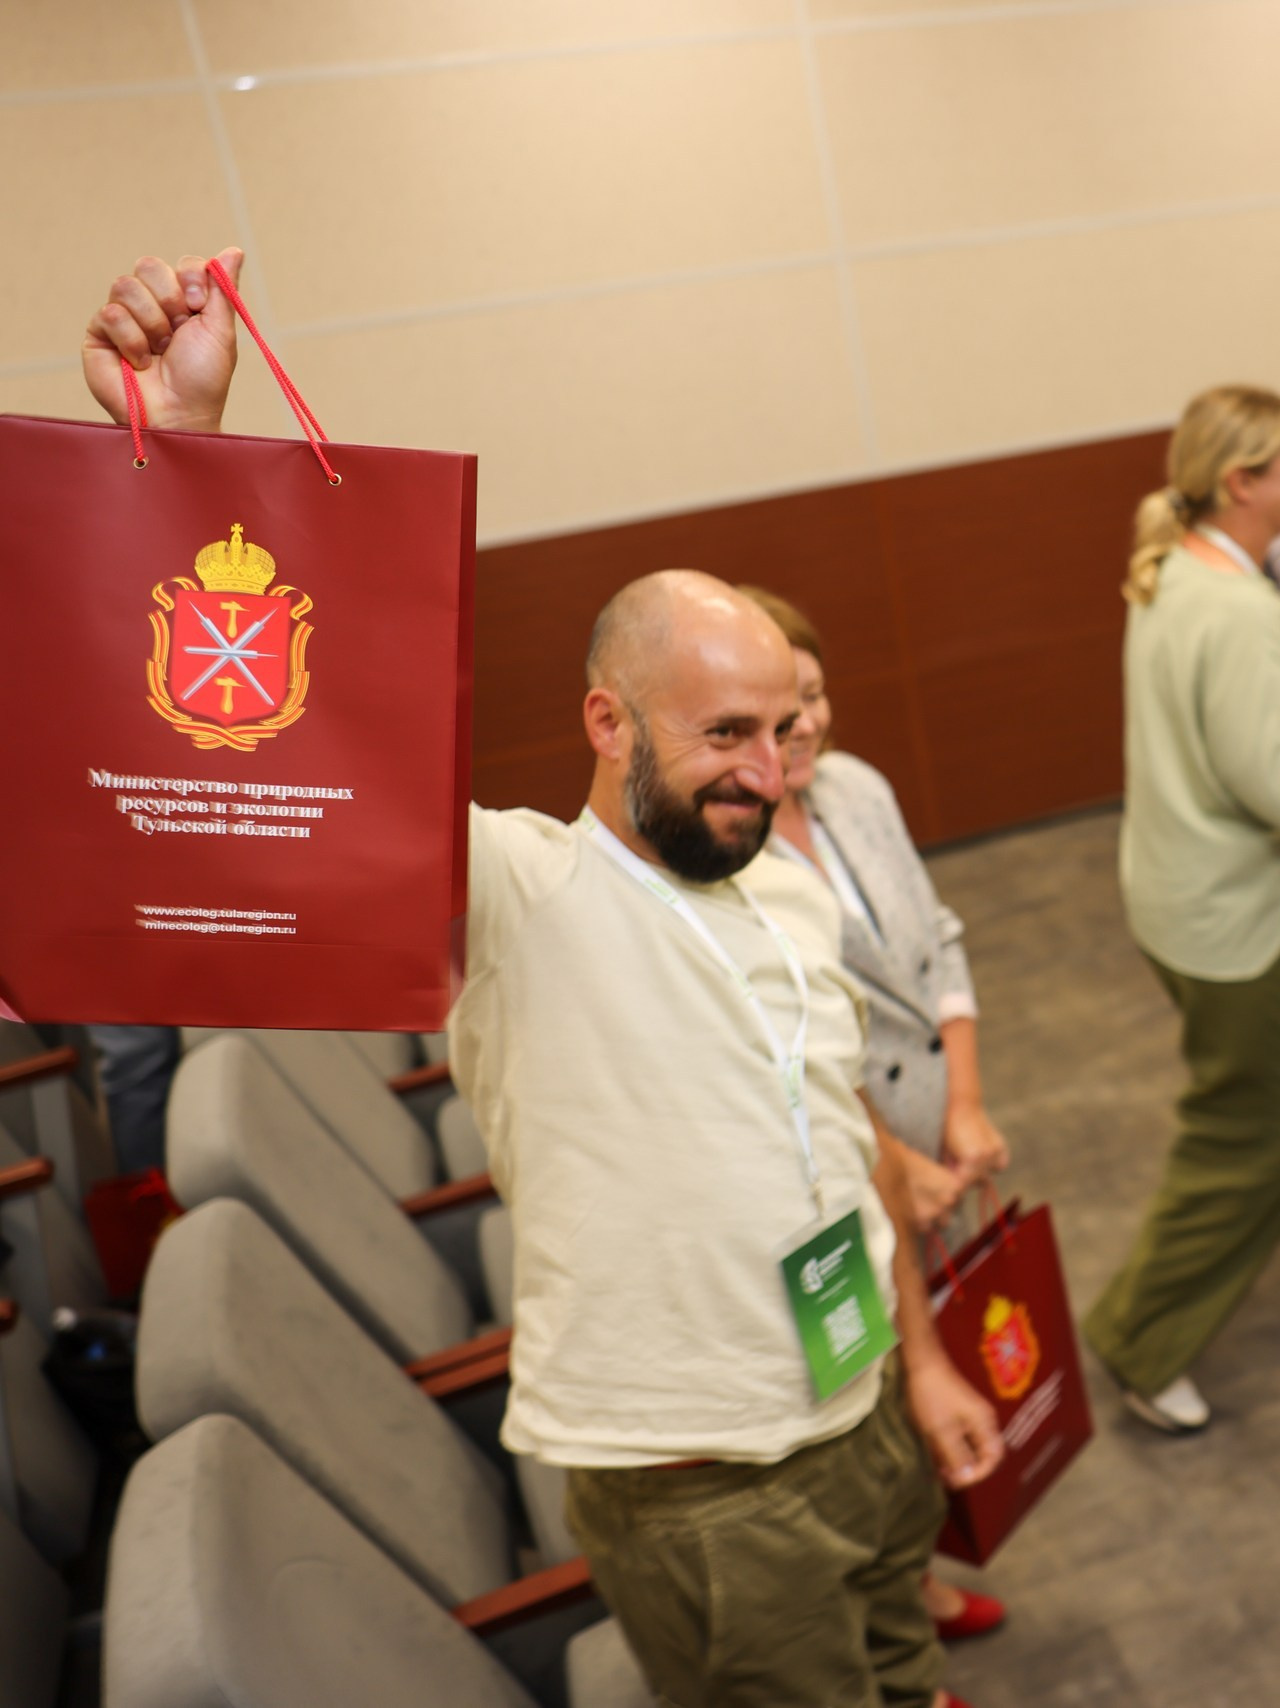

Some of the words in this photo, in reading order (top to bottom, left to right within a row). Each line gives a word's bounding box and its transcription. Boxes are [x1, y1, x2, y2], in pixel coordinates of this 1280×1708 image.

[90, 770, 238, 797] Министерство
[242, 783, 354, 801] природных
[119, 796, 209, 816] ресурсов
[212, 801, 228, 814] и
[231, 802, 323, 818] экологии
[131, 814, 227, 836] Тульской
[231, 820, 311, 838] области
[141, 905, 297, 921] www.ecolog.tularegion.ru
[142, 919, 297, 935] minecolog@tularegion.ru
